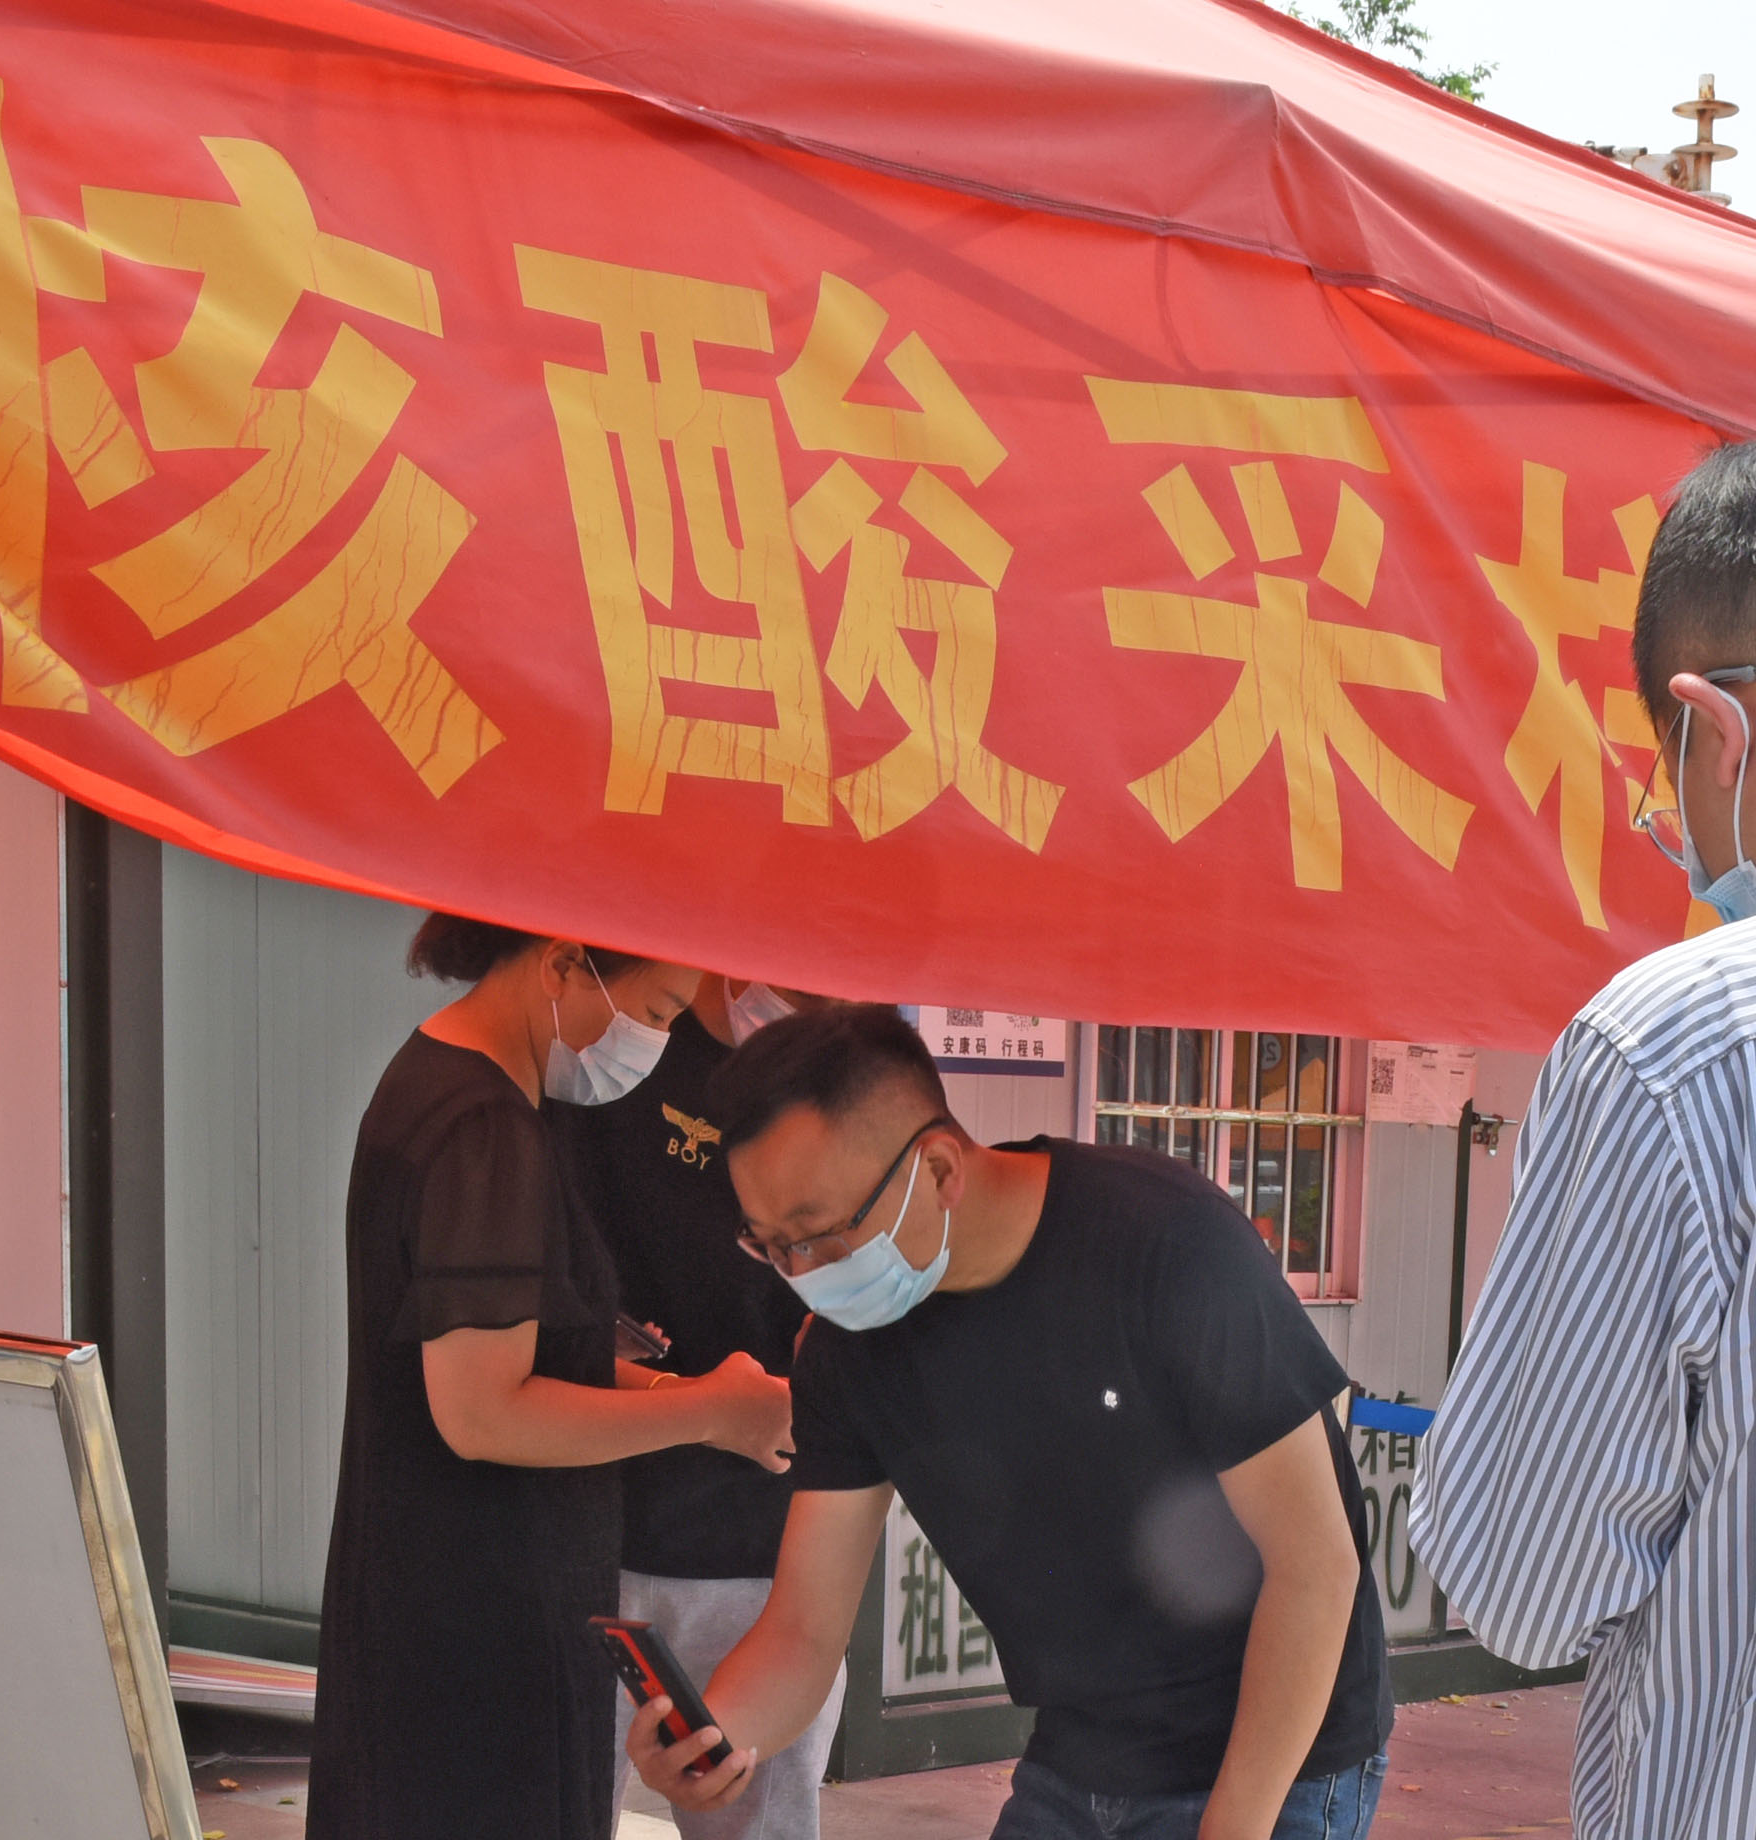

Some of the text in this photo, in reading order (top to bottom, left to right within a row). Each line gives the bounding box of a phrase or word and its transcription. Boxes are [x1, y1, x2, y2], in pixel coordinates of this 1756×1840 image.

[943, 1036, 1045, 1058] 安康码 行程码
[666, 1139, 711, 1171] BOY
